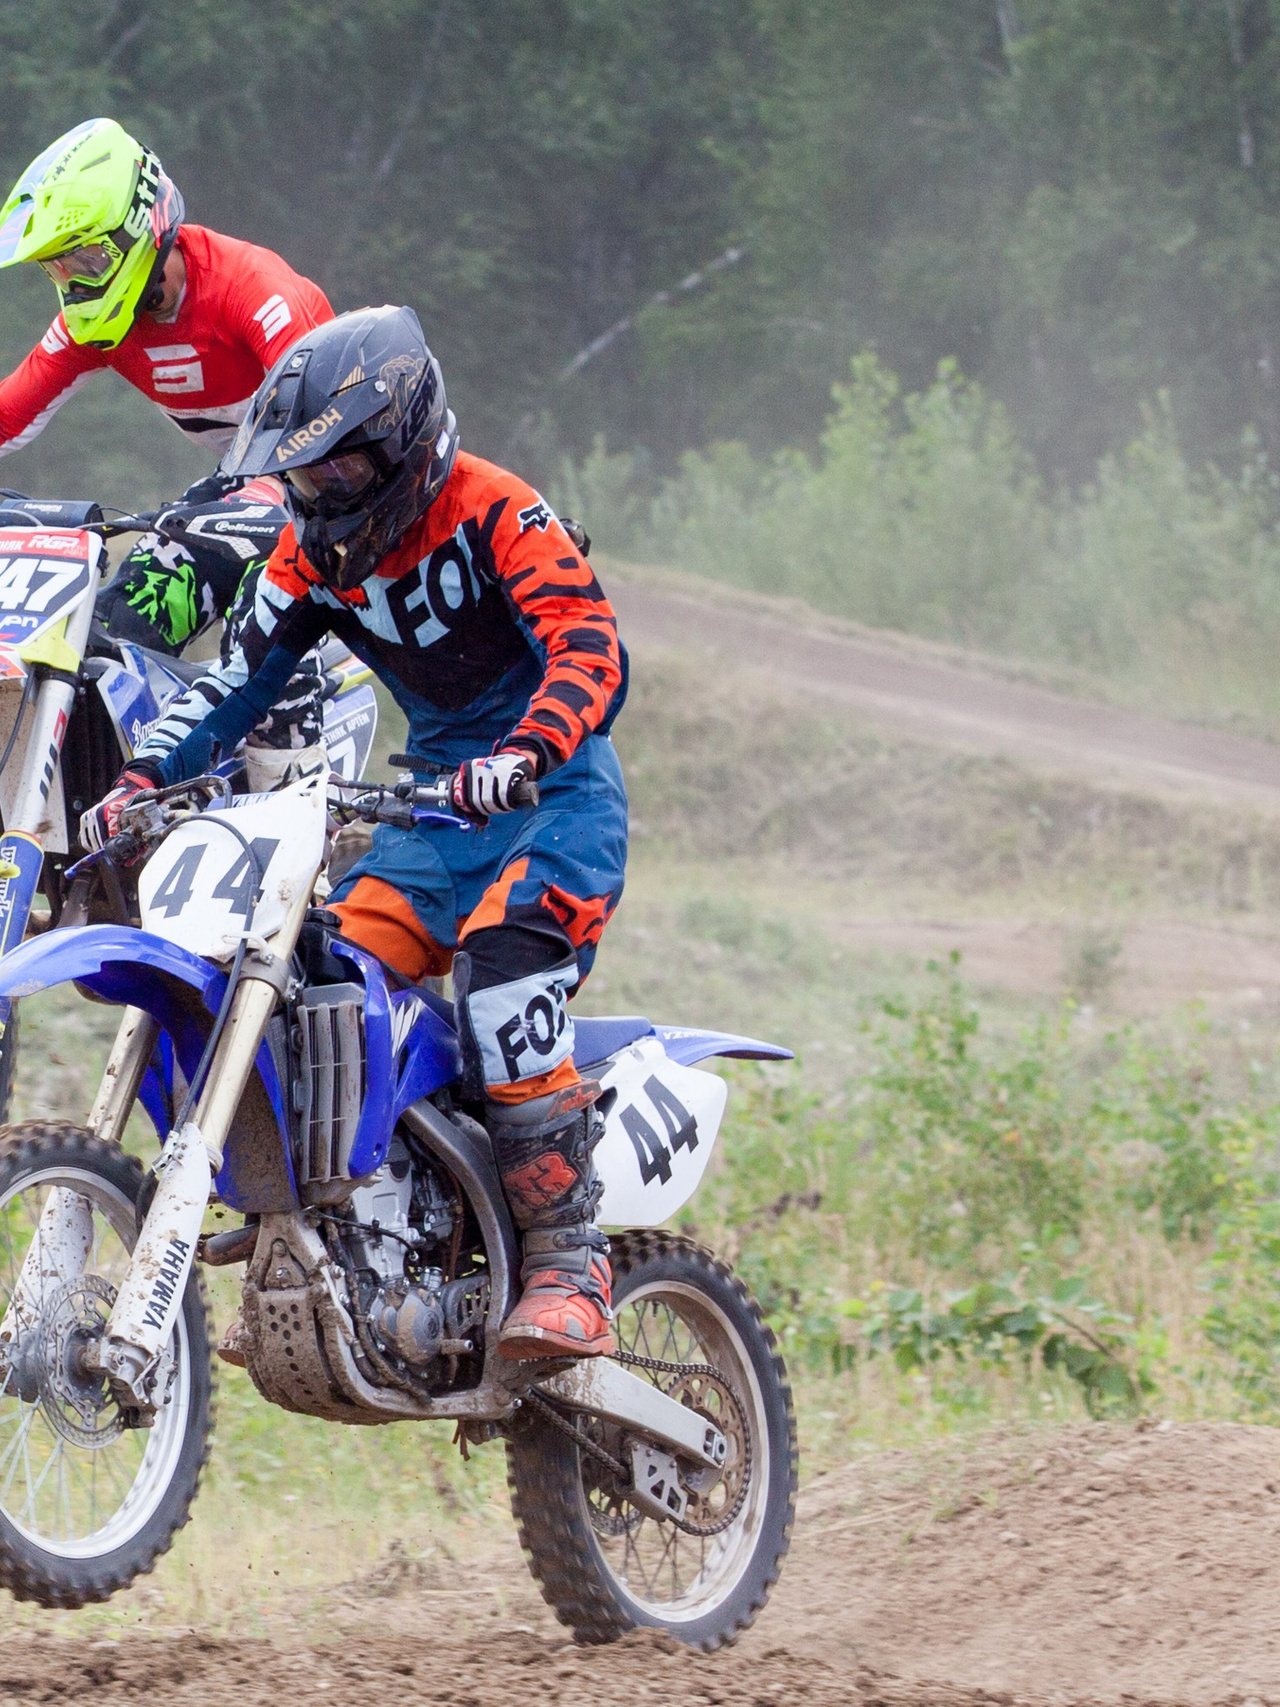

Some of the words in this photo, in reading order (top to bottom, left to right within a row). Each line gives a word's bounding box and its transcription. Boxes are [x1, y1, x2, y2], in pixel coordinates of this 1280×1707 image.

[276, 408, 343, 463] AIROH
[214, 521, 276, 533] Polisport
[149, 837, 281, 919] 44
[619, 1074, 699, 1186] 44
[142, 1239, 190, 1330] YAMAHA
